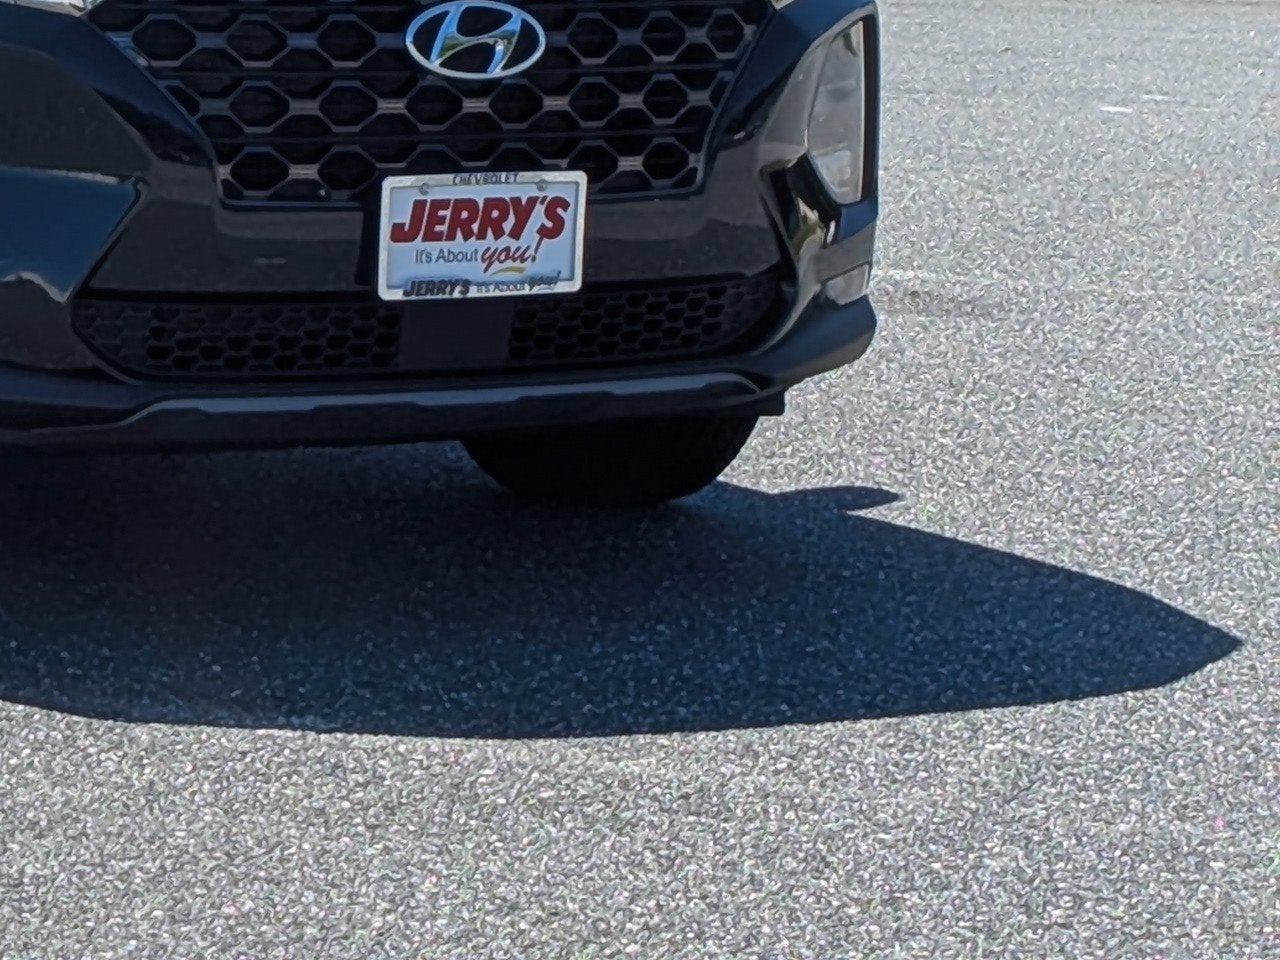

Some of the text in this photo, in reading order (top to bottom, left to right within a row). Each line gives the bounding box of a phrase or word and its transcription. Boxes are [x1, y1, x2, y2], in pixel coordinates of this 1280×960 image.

[390, 195, 571, 243] JERRY'S
[415, 237, 545, 274] It's About you!
[403, 278, 471, 297] JERRY'S
